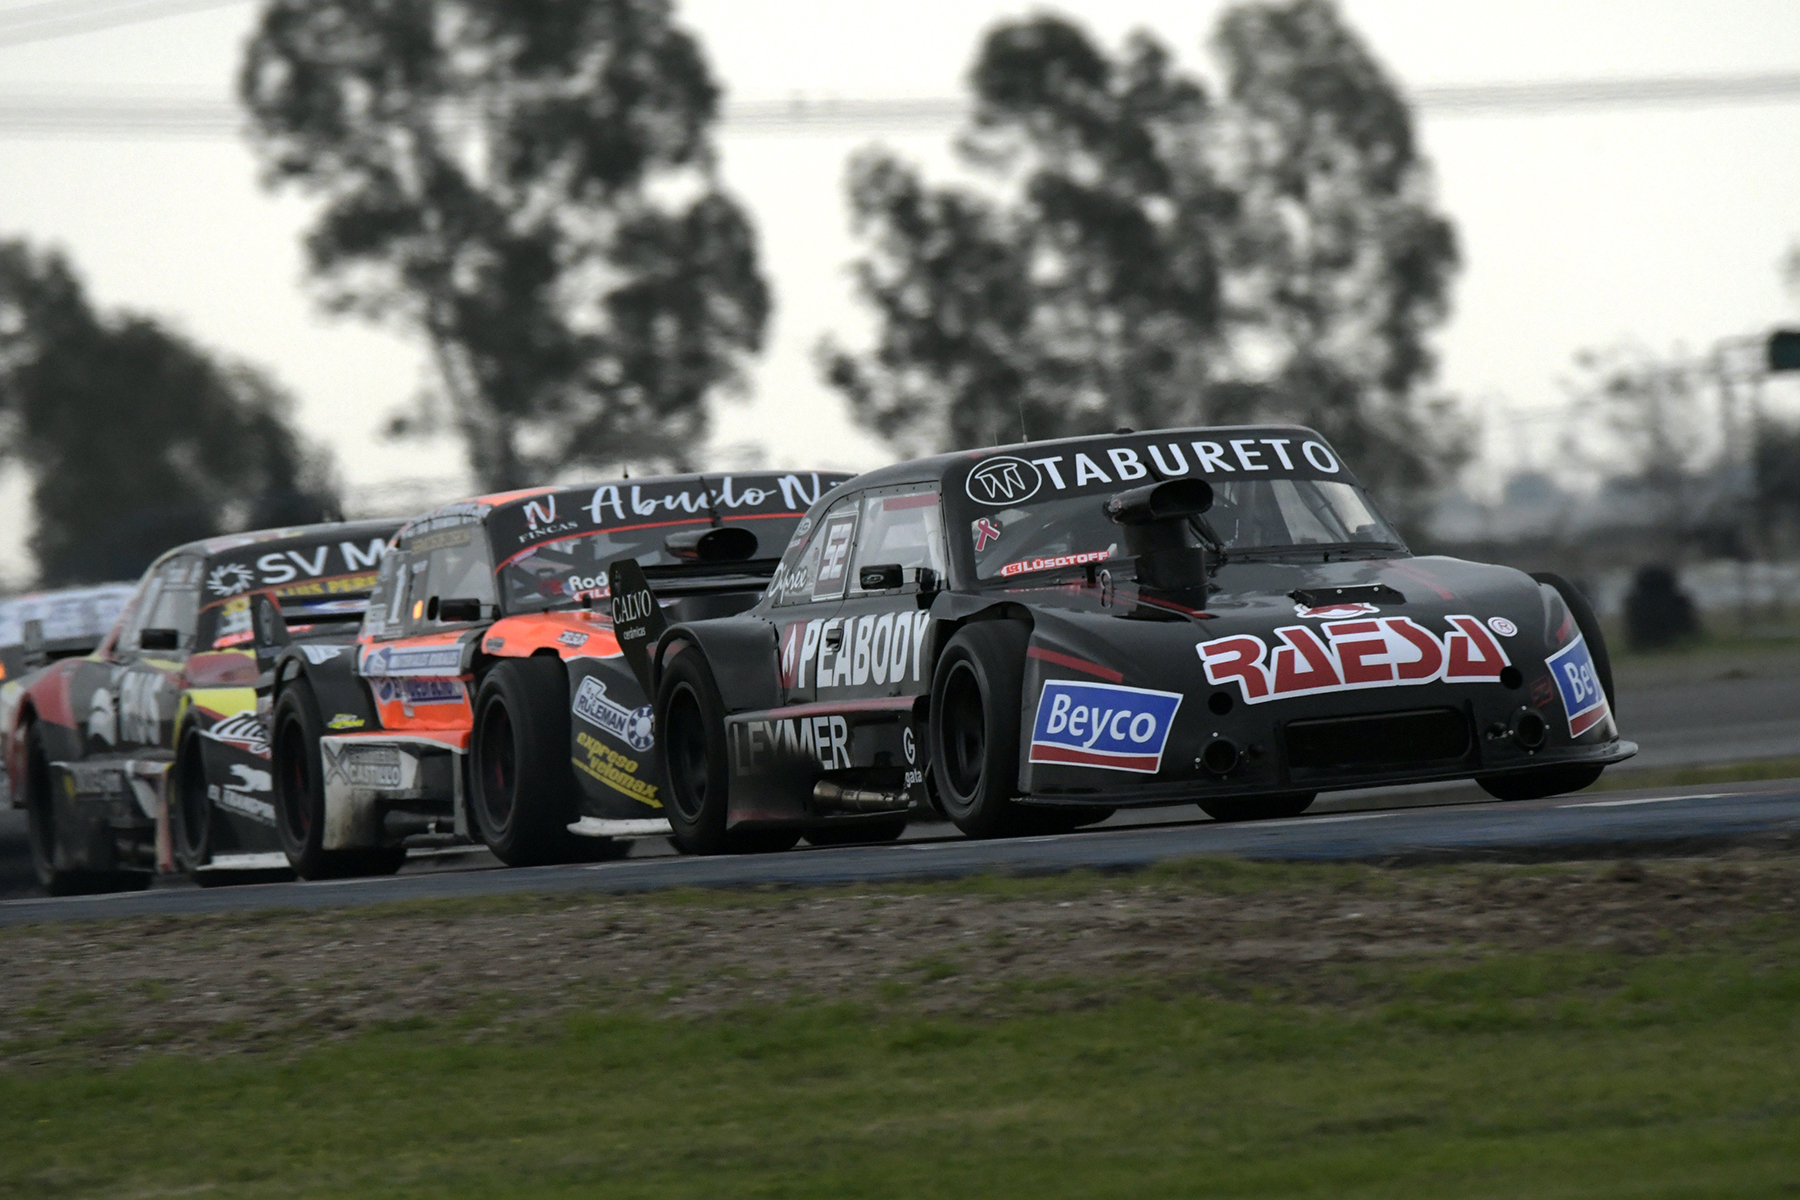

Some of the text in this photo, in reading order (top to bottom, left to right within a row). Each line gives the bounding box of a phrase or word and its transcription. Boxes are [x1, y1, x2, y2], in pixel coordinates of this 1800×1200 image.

[1032, 438, 1341, 491] TABURETO
[580, 475, 777, 525] Abuelo
[518, 520, 578, 544] FINCAS
[612, 589, 652, 625] CALVO
[798, 608, 930, 689] PEABODY
[1196, 614, 1511, 705] RAESA
[579, 694, 627, 732] RULEMAN
[1046, 693, 1157, 749] Beyco
[576, 732, 639, 773] expreso
[733, 715, 851, 776] LEYMER
[589, 757, 659, 800] velomax
[905, 768, 922, 787] gata
